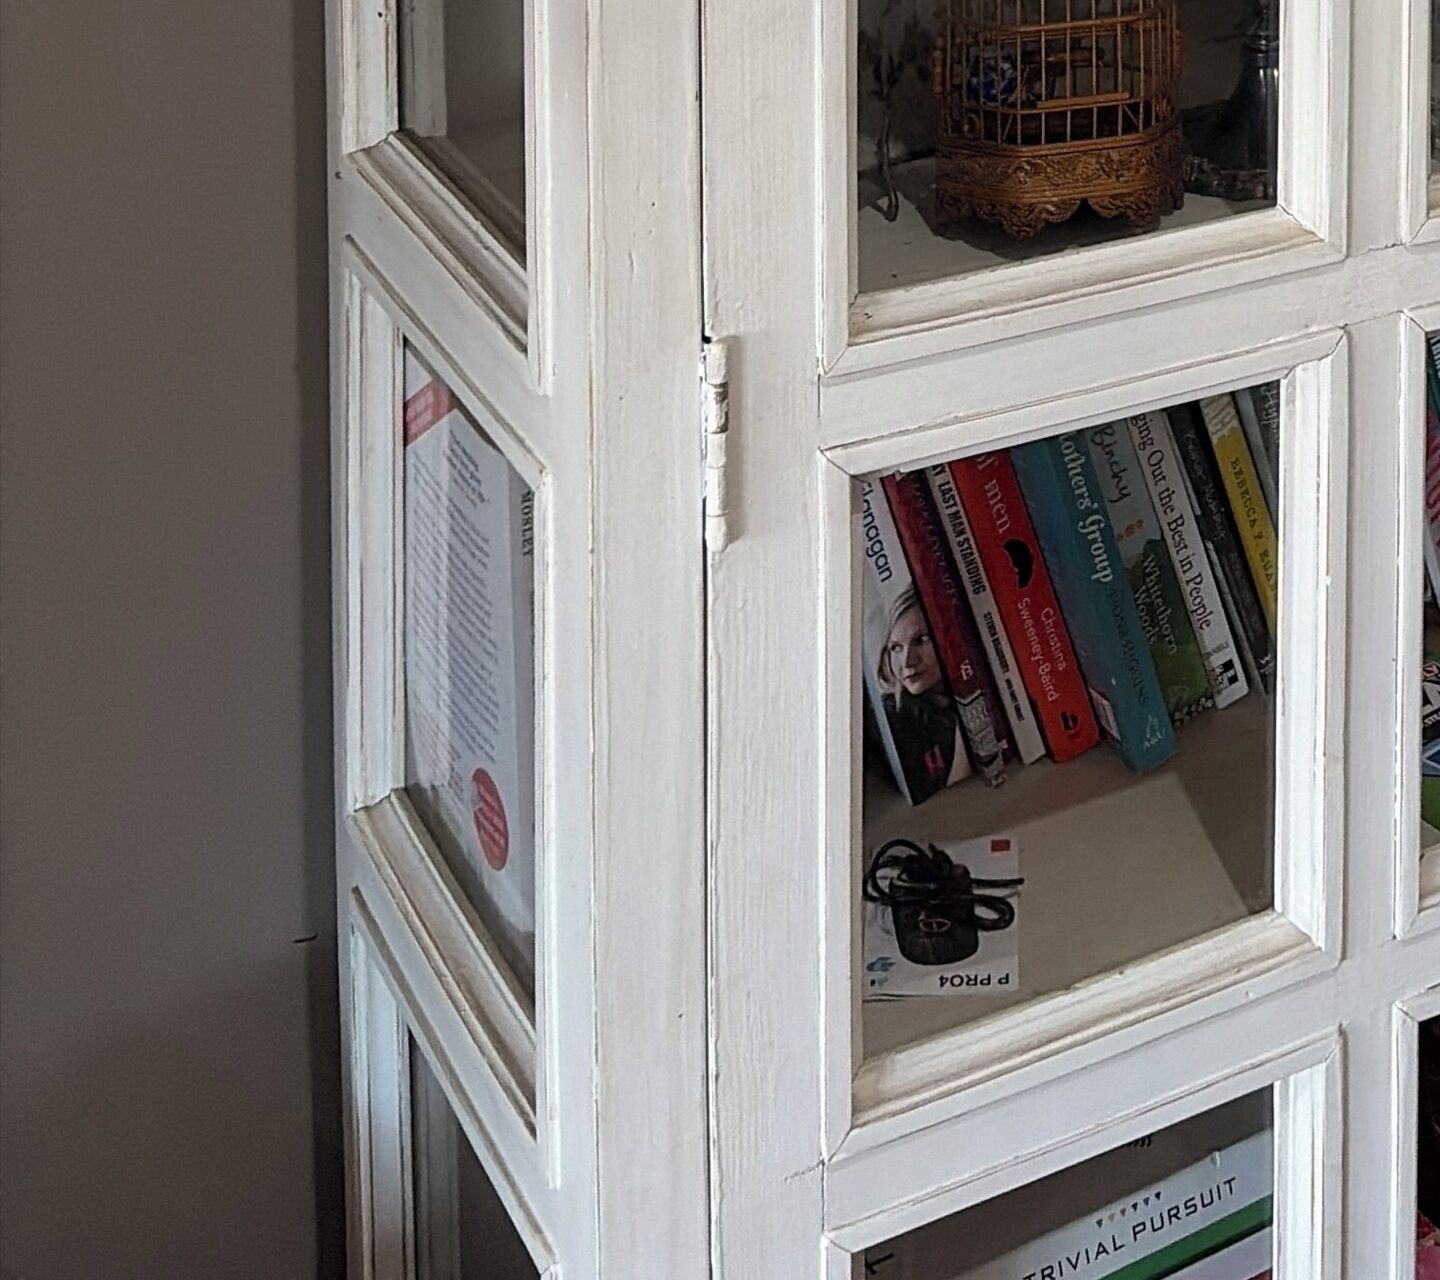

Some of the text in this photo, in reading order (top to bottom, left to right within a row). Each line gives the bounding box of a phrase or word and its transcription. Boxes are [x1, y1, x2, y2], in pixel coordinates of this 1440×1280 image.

[1091, 424, 1132, 504] Binchy
[1147, 450, 1168, 486] Out
[1230, 456, 1256, 530] REBECCA
[520, 490, 535, 557] MOSLEY
[984, 479, 1012, 534] men
[1158, 488, 1176, 515] the
[1167, 514, 1188, 549] Best
[937, 480, 957, 513] LAST
[947, 510, 967, 539] MAN
[957, 537, 987, 596] STANDING
[1077, 514, 1114, 583] Group
[1179, 552, 1196, 575] in
[1133, 585, 1160, 646] Woods
[1142, 552, 1178, 656] Whitethorn
[1185, 572, 1214, 631] People
[1017, 596, 1060, 702] Sweeney-Baird
[1040, 607, 1067, 672] Christina
[938, 973, 992, 989] PRO4
[1131, 1176, 1238, 1243] PURSUIT
